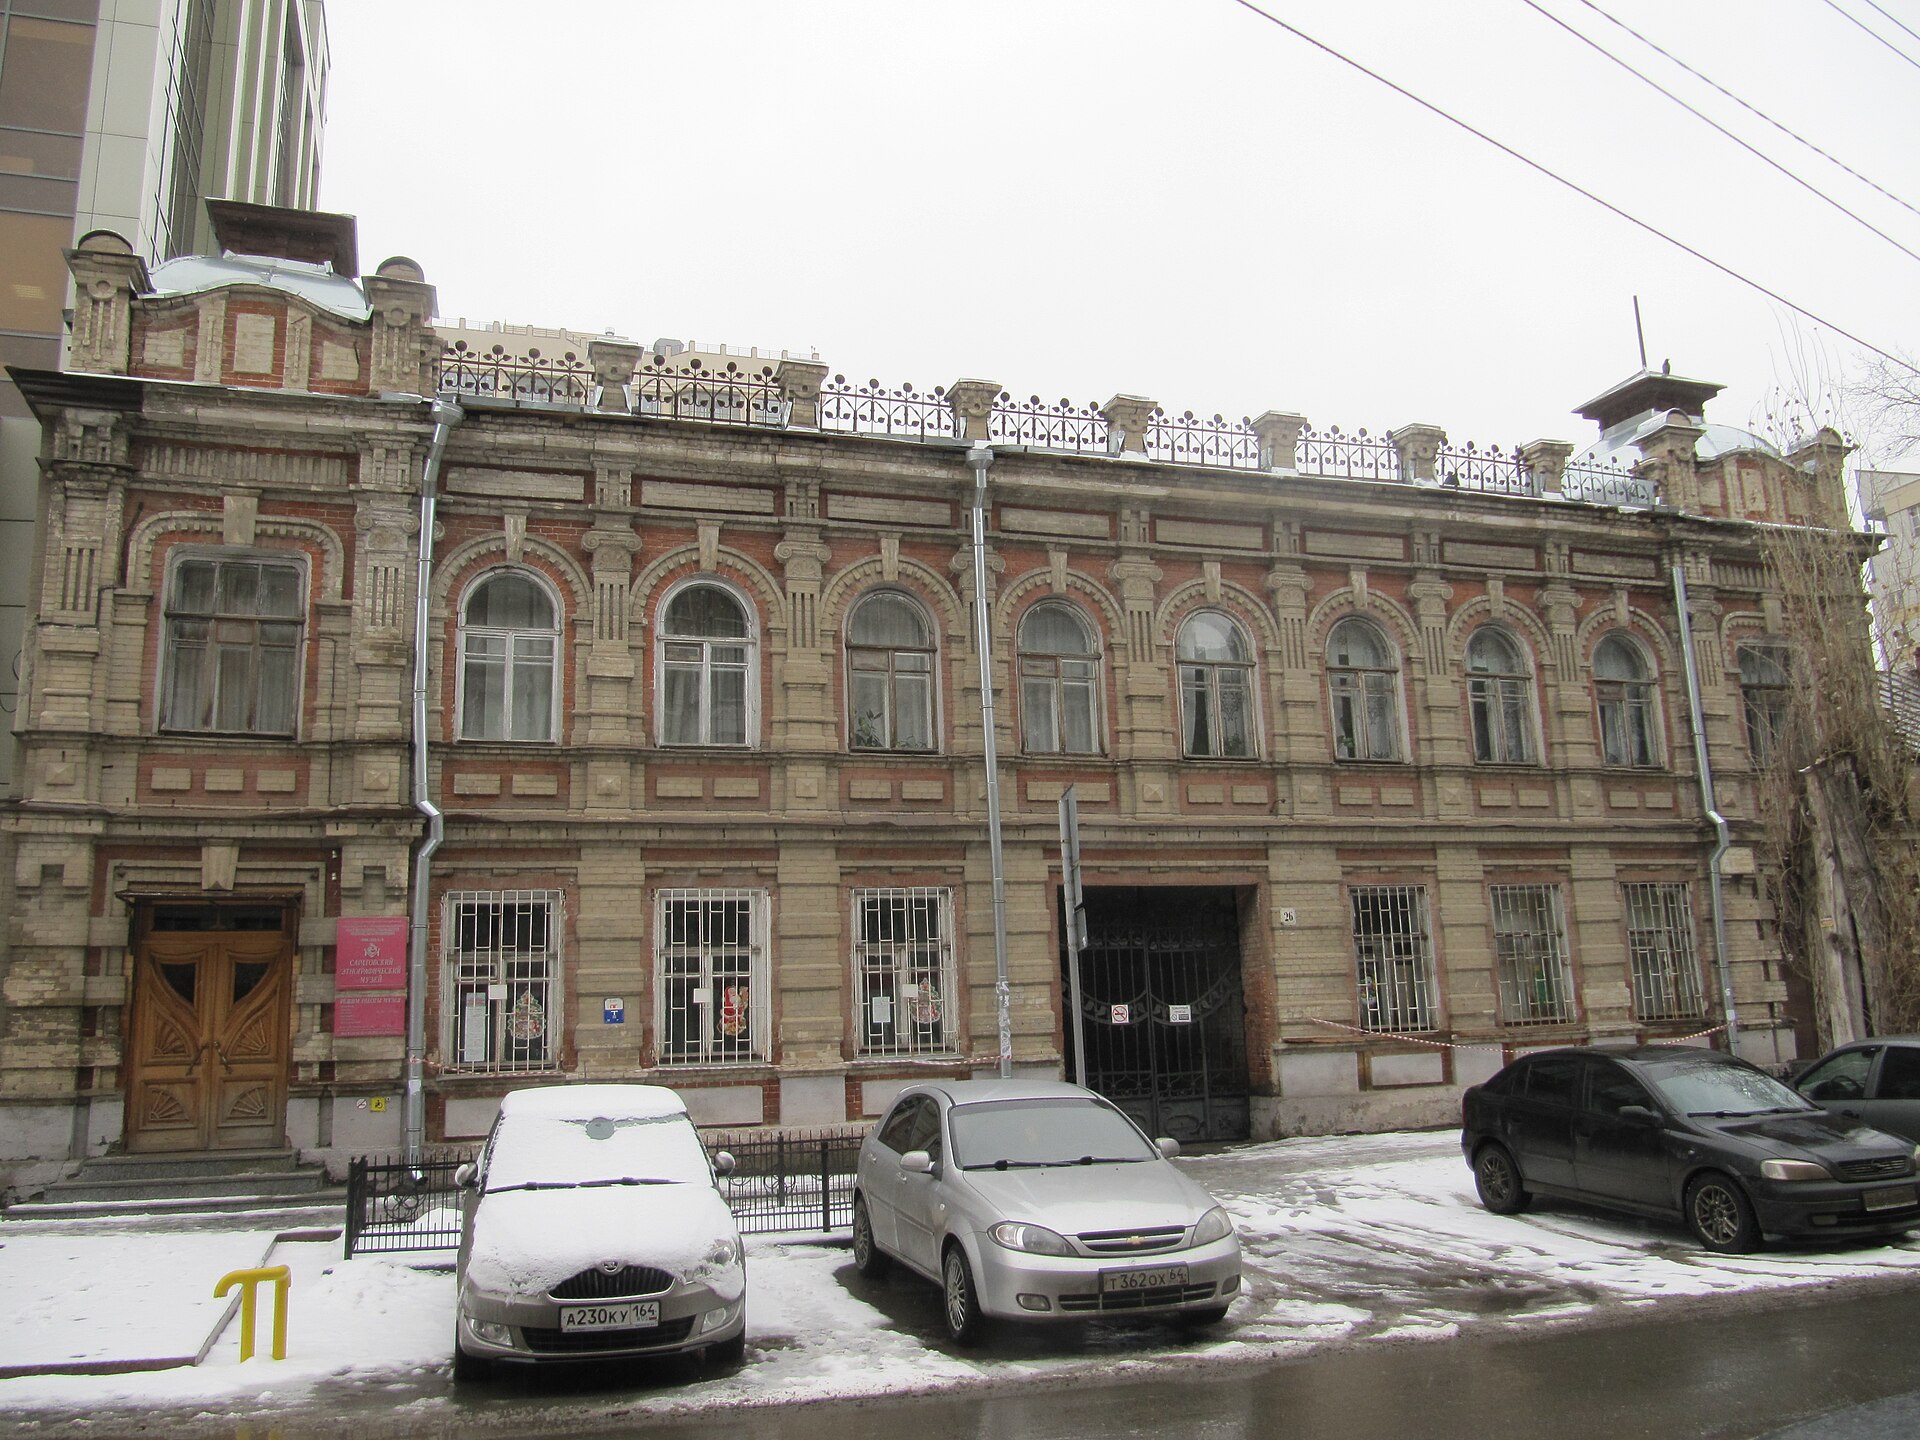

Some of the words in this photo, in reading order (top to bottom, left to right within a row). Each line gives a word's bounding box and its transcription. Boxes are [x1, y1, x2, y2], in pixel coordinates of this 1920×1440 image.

[1284, 911, 1293, 921] 26
[1169, 1268, 1184, 1280] 64
[566, 1308, 628, 1326] А230КУ
[632, 1303, 655, 1317] 164
